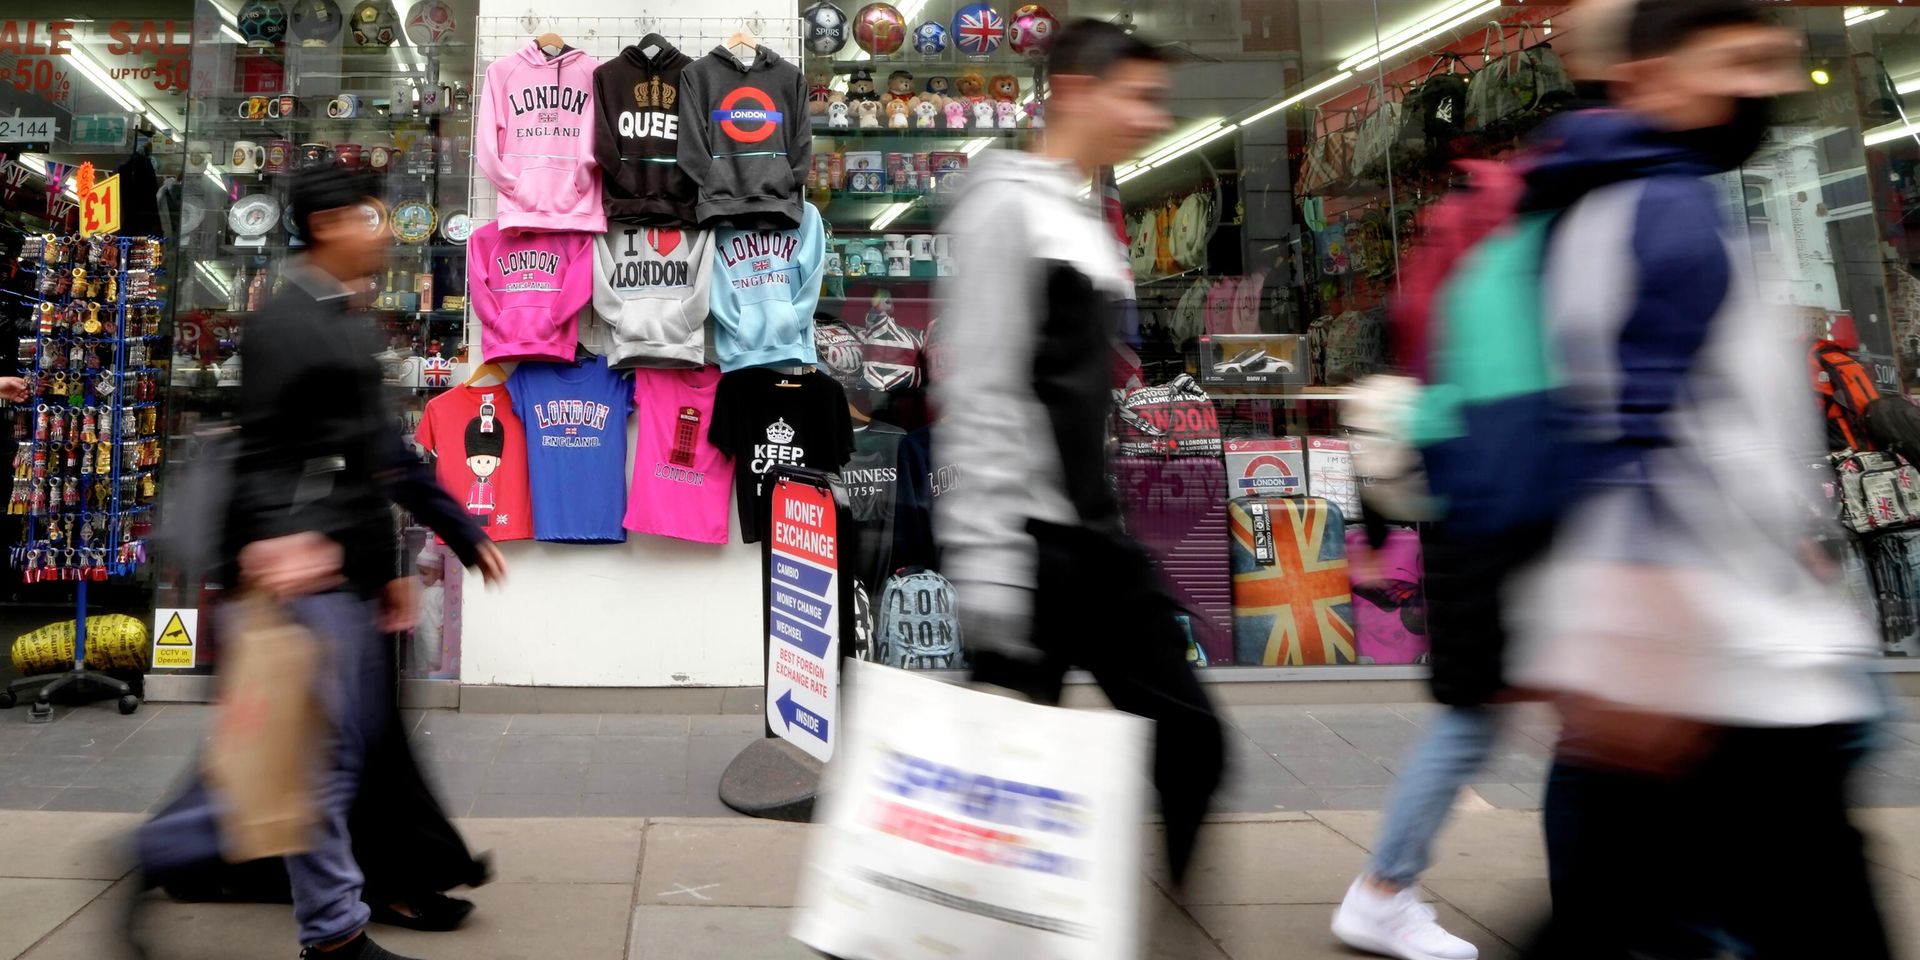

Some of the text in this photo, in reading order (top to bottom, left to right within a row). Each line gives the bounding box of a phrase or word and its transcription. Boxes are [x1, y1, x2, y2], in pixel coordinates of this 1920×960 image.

[0, 19, 75, 55] ALE
[815, 28, 840, 37] SPURS
[509, 85, 589, 116] LONDON
[618, 111, 679, 140] QUEE
[731, 111, 766, 119] LONDON
[0, 121, 47, 137] 2-144
[516, 127, 580, 138] ENGLAND
[84, 186, 111, 232] £1
[624, 229, 638, 256] I
[719, 231, 798, 268] LONDON
[497, 250, 560, 276] LONDON
[616, 260, 688, 287] LONDON
[732, 272, 790, 289] ENGLAND
[534, 400, 610, 431] LONDON
[1138, 407, 1218, 433] ONDON
[542, 436, 601, 448] ENGLAND
[754, 444, 804, 461] KEEP
[655, 463, 705, 486] LONDON
[1252, 478, 1286, 487] LONDON
[785, 498, 825, 528] MONEY
[775, 522, 834, 559] EXCHANGE
[777, 562, 799, 580] CAMBIO
[776, 591, 822, 620] MONEY CHANGE
[776, 620, 803, 642] WECHSEL
[157, 657, 190, 665] Operation
[779, 648, 825, 679] BEST FOREIGN
[776, 662, 828, 699] EXCHANGE RATE
[795, 708, 820, 733] INSIDE
